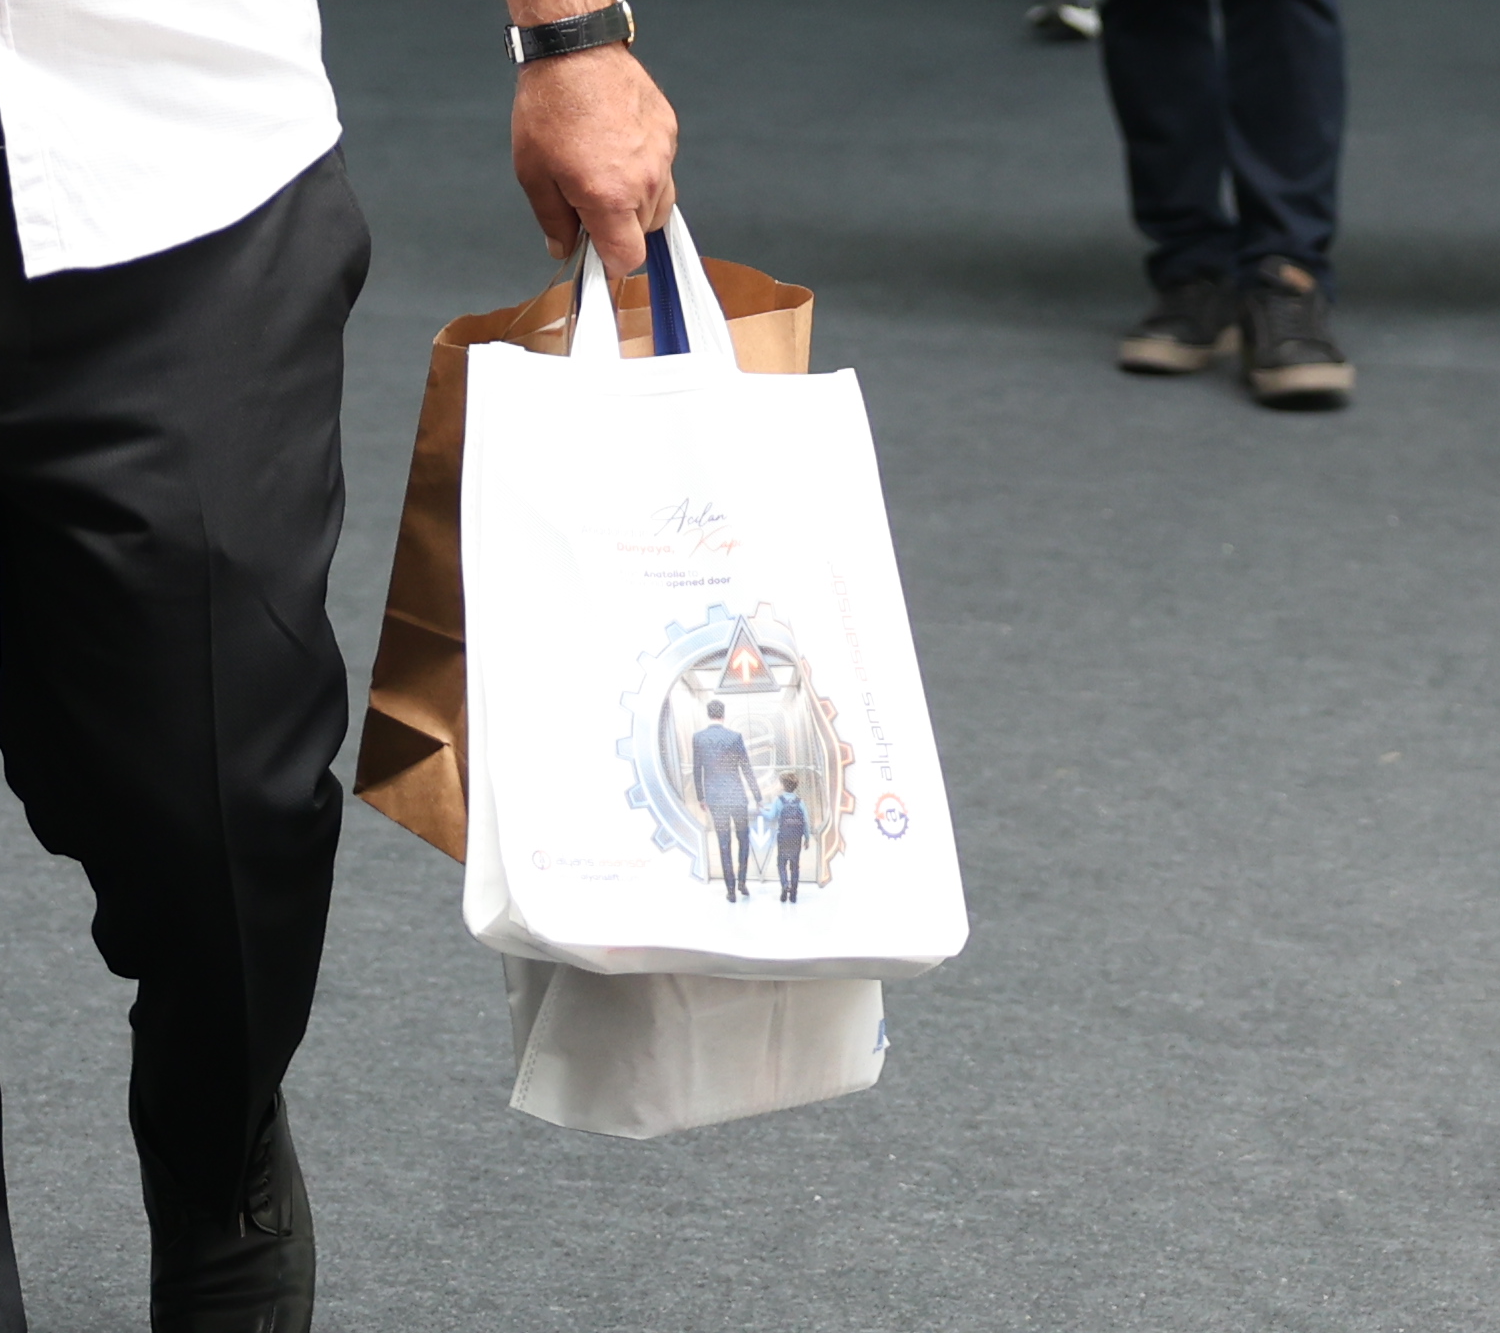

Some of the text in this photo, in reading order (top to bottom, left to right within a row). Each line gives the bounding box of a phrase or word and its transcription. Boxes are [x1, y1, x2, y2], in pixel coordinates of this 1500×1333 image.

[643, 570, 686, 578] Anatolia
[665, 578, 705, 588] opened
[707, 575, 732, 585] door
